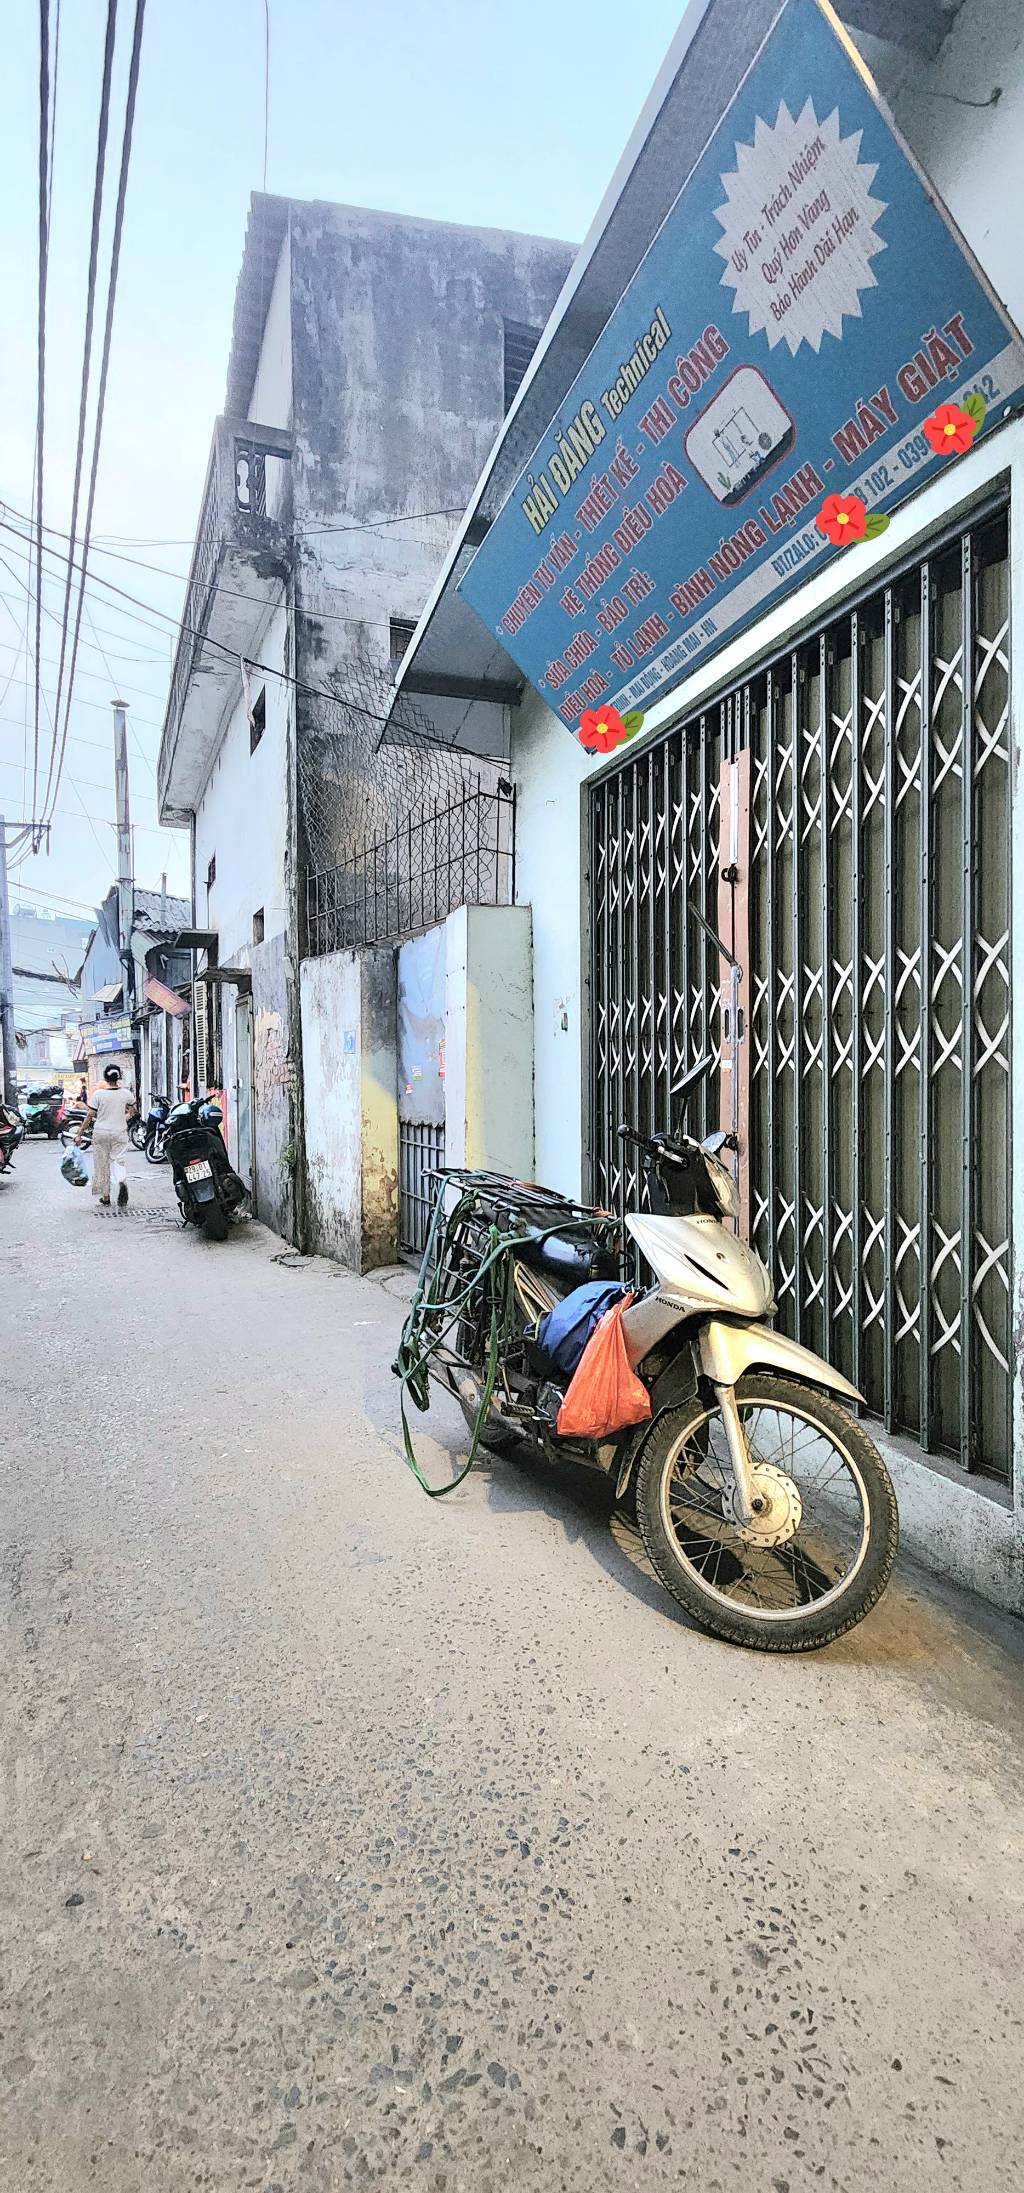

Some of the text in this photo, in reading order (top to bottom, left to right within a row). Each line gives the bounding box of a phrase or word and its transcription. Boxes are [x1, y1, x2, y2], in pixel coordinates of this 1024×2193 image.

[732, 248, 749, 273] Uy
[761, 183, 793, 228] Trách
[787, 136, 826, 191] Nhiệm
[761, 247, 784, 284] Quý
[797, 188, 831, 231] Vàng
[788, 260, 818, 301] Hành
[832, 207, 859, 245] Hạn
[502, 580, 544, 636] CHUYÊN
[532, 558, 556, 591] TƯ
[545, 531, 579, 574] VẤN
[575, 473, 620, 533] THIẾT
[609, 436, 640, 490] KẾ
[638, 394, 677, 447] THI
[667, 324, 731, 408] CÔNG
[522, 304, 673, 536] HẢI ĐĂNG Technical
[864, 465, 895, 496] 102
[558, 691, 588, 722] ĐIỀU
[580, 669, 611, 702] HOÀ
[610, 641, 635, 672] TỦ
[626, 612, 670, 658] LẠNH
[668, 567, 717, 618] BÌNH
[707, 518, 768, 582] NÓNG
[758, 461, 825, 535] LẠNH
[831, 384, 899, 466] MÁY
[897, 310, 976, 405] GIẶT
[560, 460, 689, 619] HỆ THỐNG ĐIỀU HOÀ
[544, 660, 573, 689] SỬA
[563, 630, 600, 670] CHỮA
[596, 596, 630, 635] BẢO
[620, 567, 656, 608] TRÌ:
[629, 681, 646, 699] MAI
[682, 632, 702, 653] MAI
[701, 617, 718, 638] HN
[655, 1296, 686, 1312] HONDA
